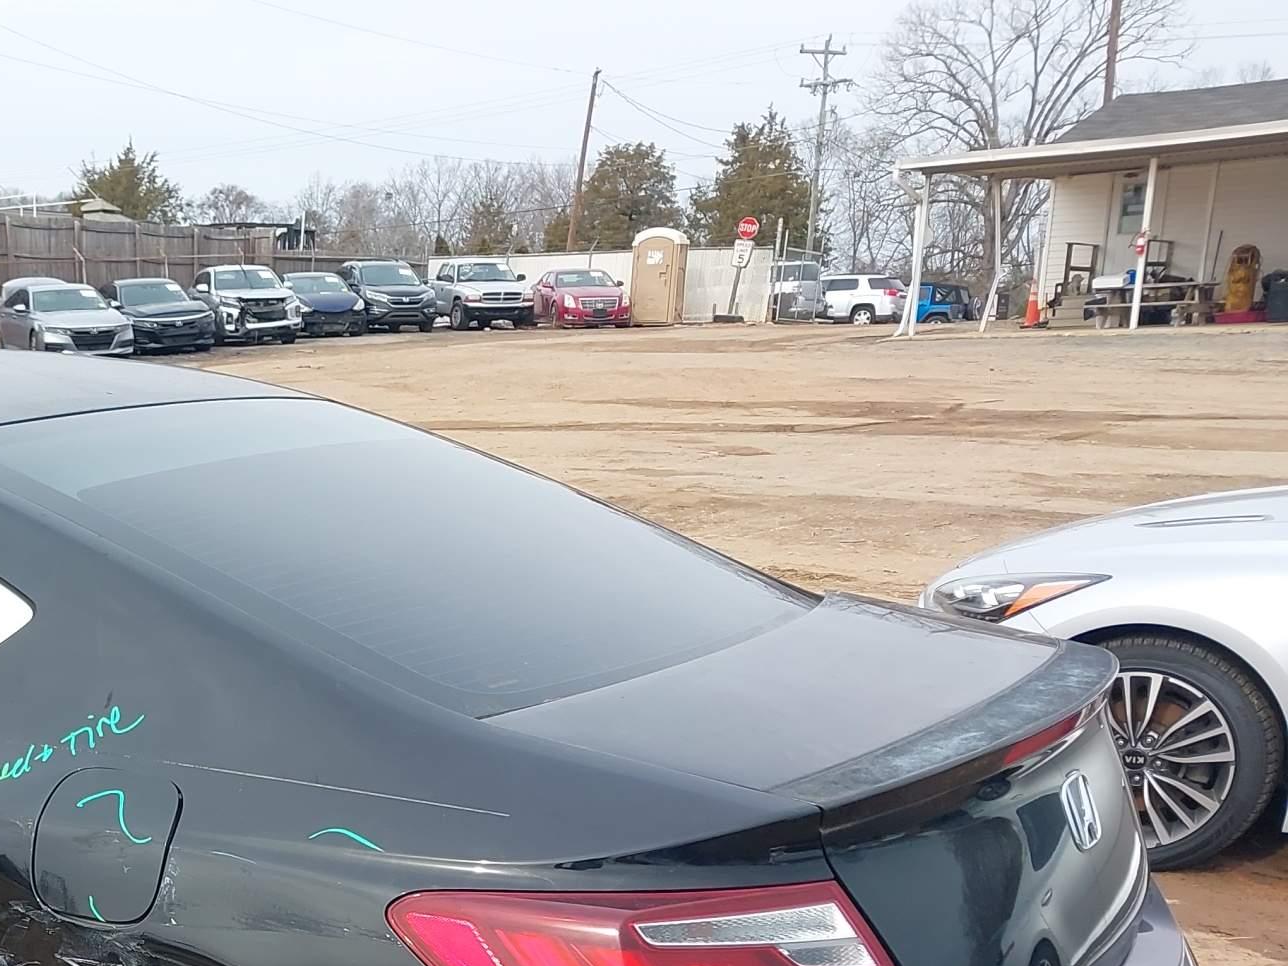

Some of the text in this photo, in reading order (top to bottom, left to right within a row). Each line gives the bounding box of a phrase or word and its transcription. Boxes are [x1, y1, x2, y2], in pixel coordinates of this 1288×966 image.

[739, 223, 757, 233] STOP
[737, 254, 745, 264] 5
[1124, 755, 1145, 765] KIA
